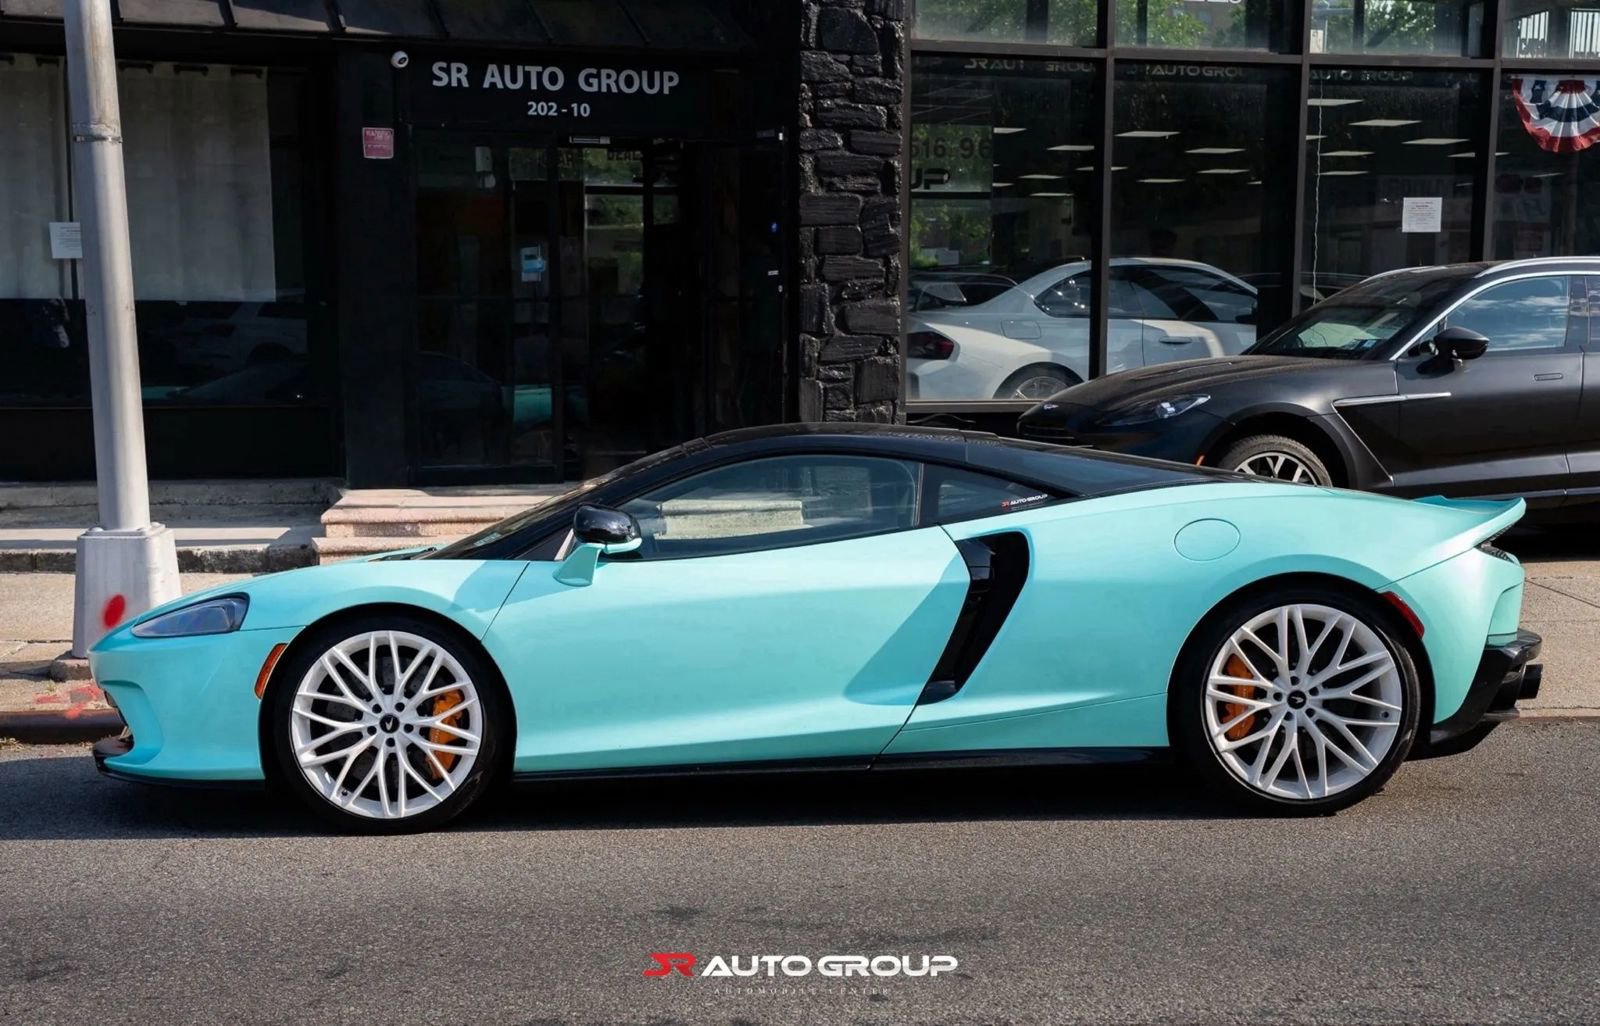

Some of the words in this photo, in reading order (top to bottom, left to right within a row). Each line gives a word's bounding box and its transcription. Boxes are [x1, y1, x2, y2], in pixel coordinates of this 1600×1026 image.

[431, 61, 470, 88] SR
[483, 63, 565, 91] AUTO
[577, 68, 680, 95] GROUP
